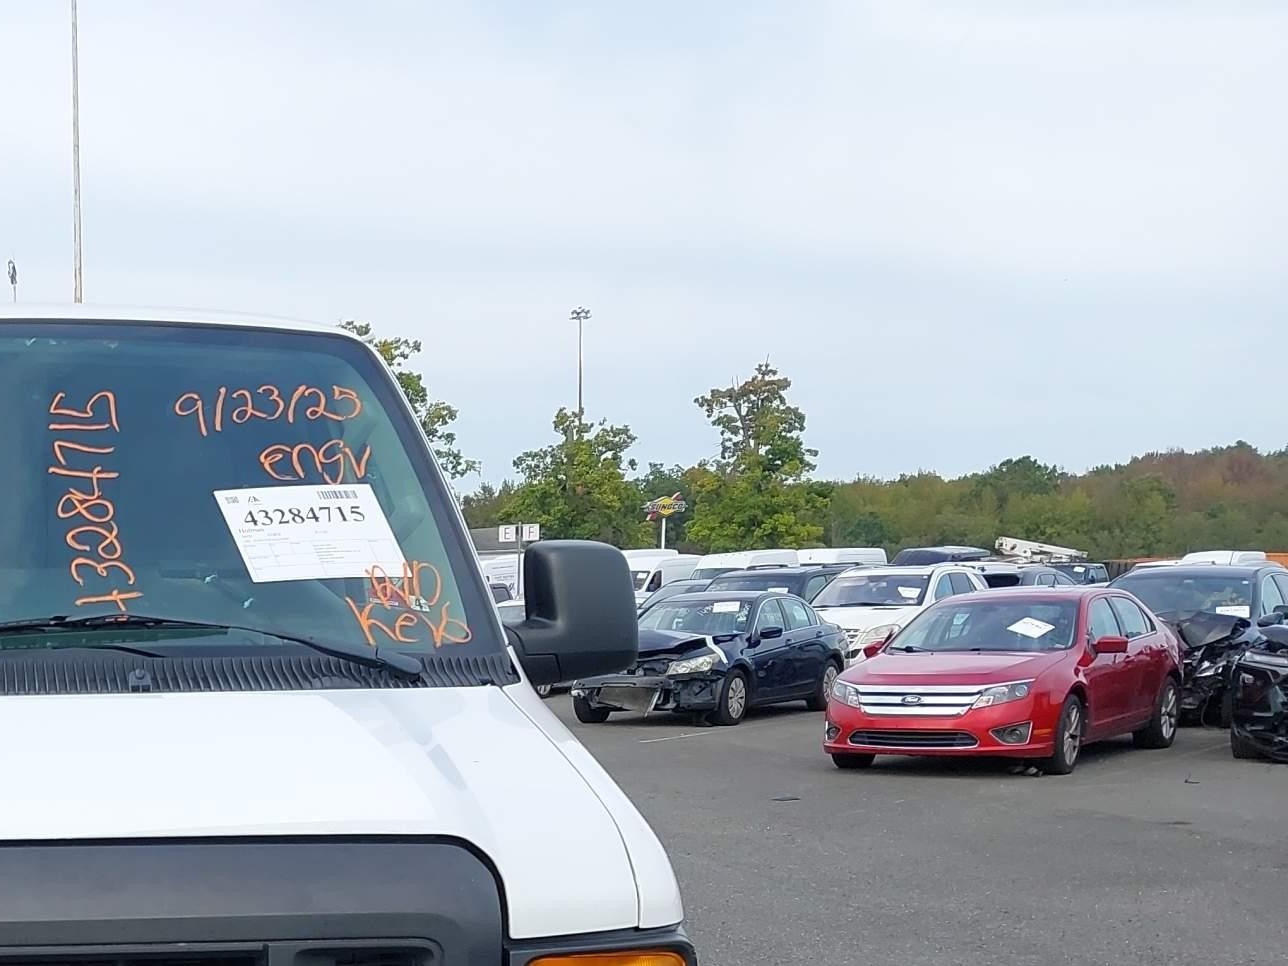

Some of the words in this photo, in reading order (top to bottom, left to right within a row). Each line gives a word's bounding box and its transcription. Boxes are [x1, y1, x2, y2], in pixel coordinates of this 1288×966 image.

[174, 383, 362, 438] 9/23/25
[48, 390, 144, 621] 43284715
[244, 505, 366, 527] 43284715
[503, 527, 512, 540] E
